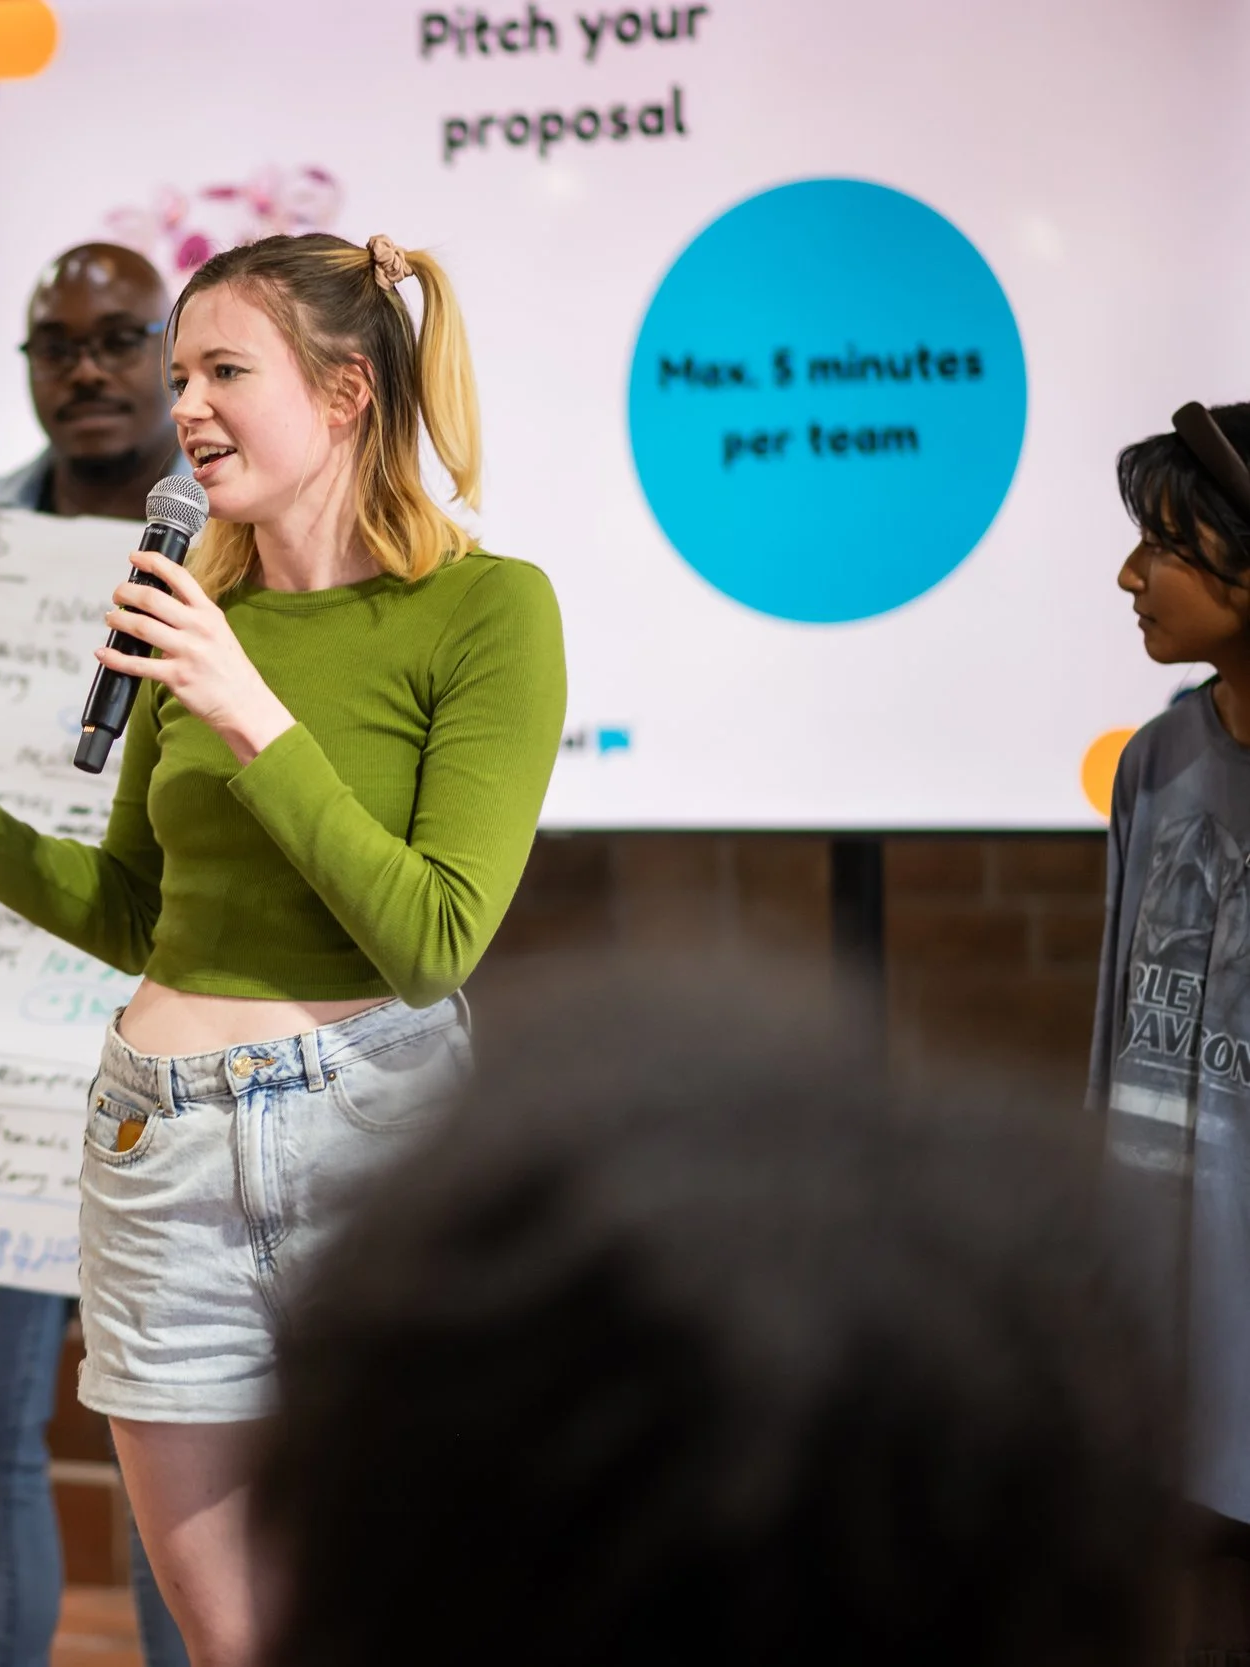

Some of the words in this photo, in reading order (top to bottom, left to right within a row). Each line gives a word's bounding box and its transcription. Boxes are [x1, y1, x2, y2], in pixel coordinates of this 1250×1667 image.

[420, 2, 558, 60] Pitch
[578, 2, 709, 62] your
[442, 84, 688, 167] proposal
[657, 350, 758, 392] Max.
[771, 346, 794, 389] 5
[806, 341, 986, 387] minutes
[720, 425, 793, 471] per
[806, 419, 921, 457] team
